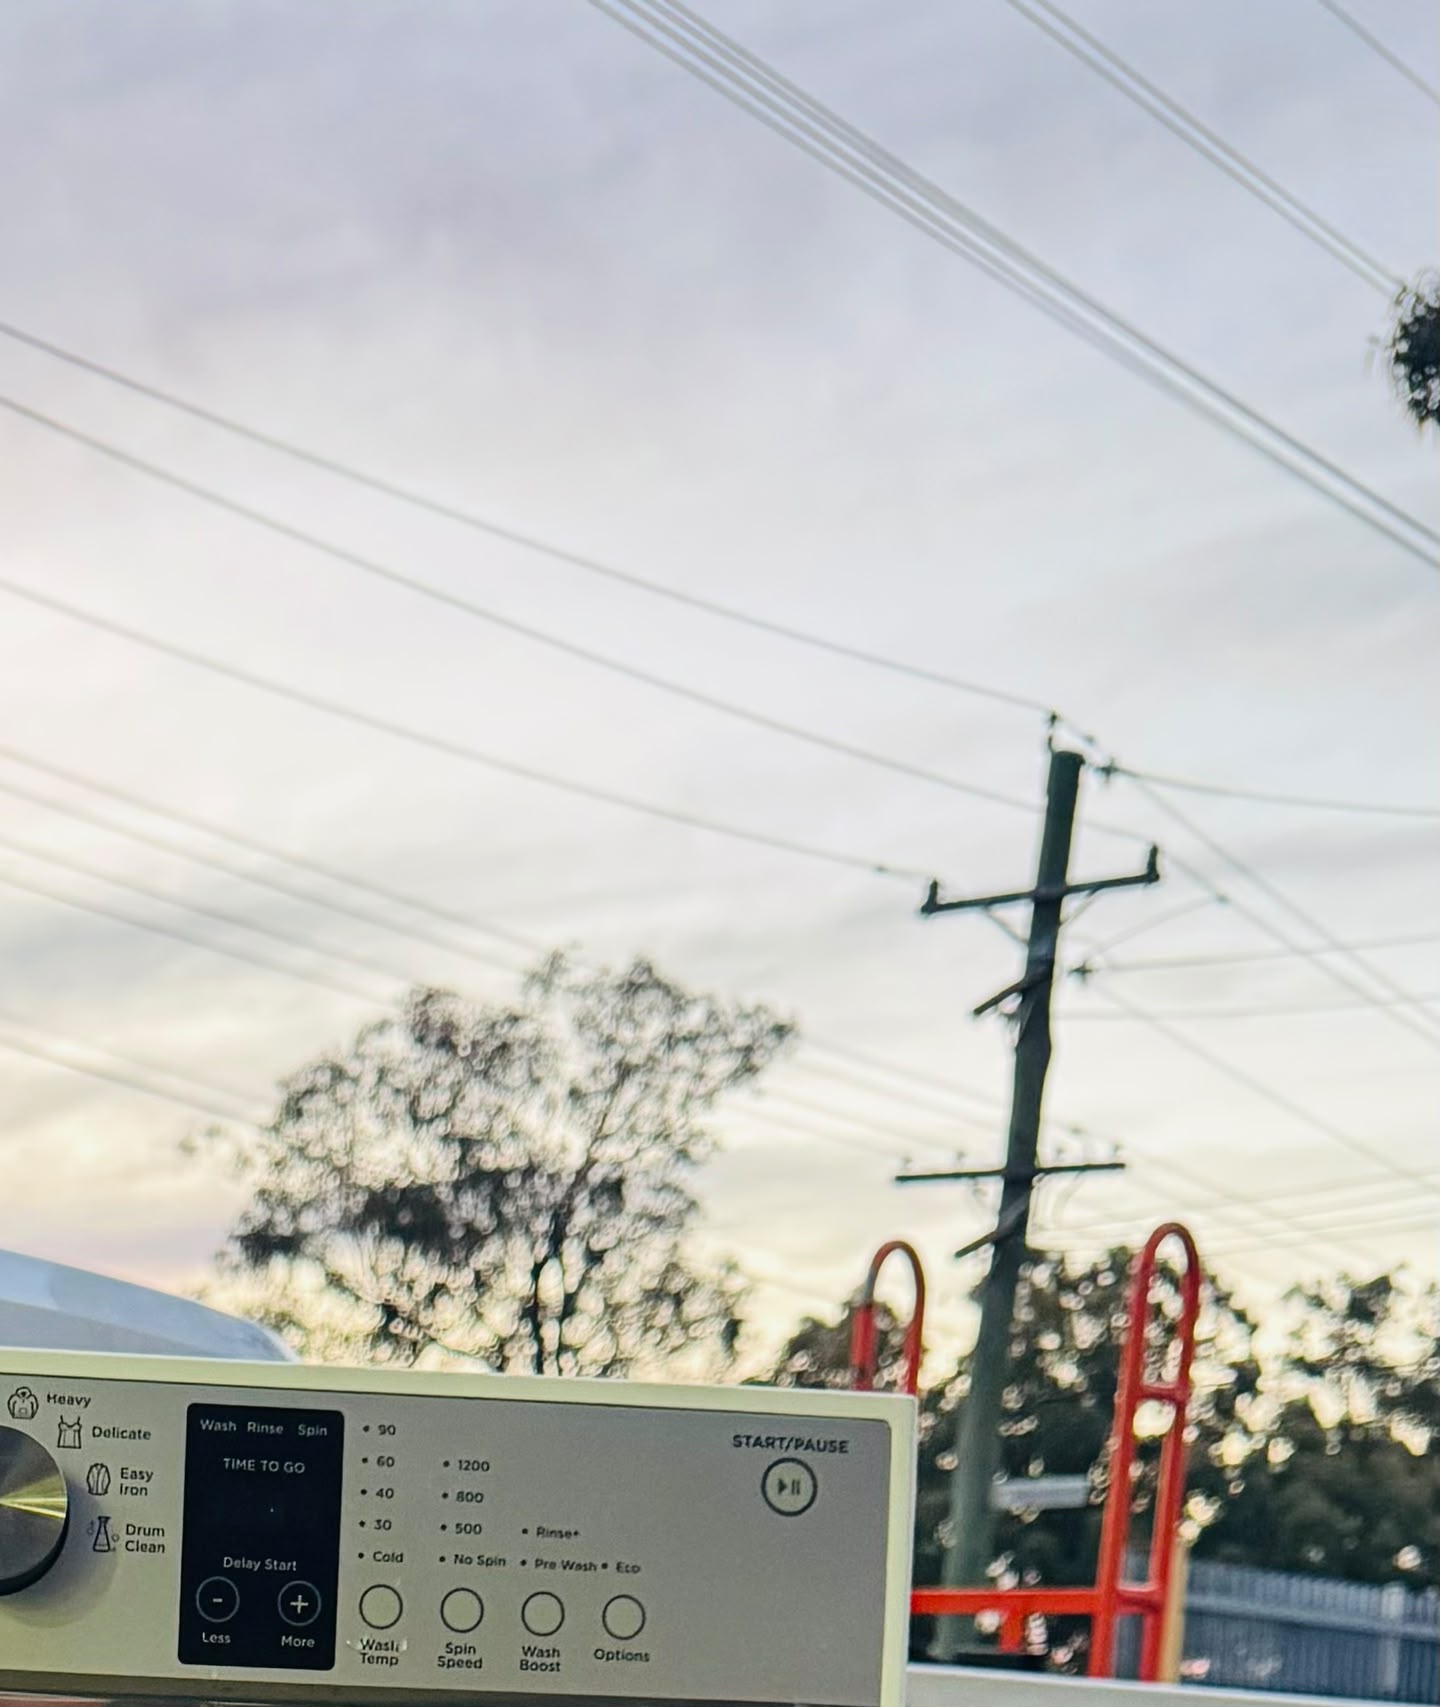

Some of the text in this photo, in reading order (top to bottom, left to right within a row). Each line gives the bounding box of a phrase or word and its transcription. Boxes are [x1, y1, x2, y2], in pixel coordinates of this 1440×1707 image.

[47, 1393, 91, 1409] Heavy
[92, 1426, 151, 1441] Delicate
[200, 1419, 328, 1438] Wash Rinse Spin
[378, 1424, 396, 1436] 90
[732, 1434, 850, 1454] START/PAUSE
[223, 1458, 306, 1474] TIME TO GO
[376, 1456, 395, 1467] 60
[458, 1459, 490, 1472] 1200
[120, 1467, 154, 1484] Easy
[119, 1483, 148, 1497] Iron
[375, 1488, 394, 1499] 40
[456, 1491, 484, 1503] 800
[125, 1523, 165, 1538] Drum
[374, 1519, 392, 1531] 30
[455, 1523, 482, 1535] 500
[536, 1526, 579, 1539] Rinse+
[124, 1539, 166, 1554] Clean
[373, 1551, 404, 1563] Cold
[454, 1554, 506, 1567] No Spin
[223, 1556, 297, 1572] Delay Start
[535, 1558, 597, 1571] Pre Wash
[616, 1562, 641, 1573] Eco
[202, 1632, 231, 1645] Less
[281, 1634, 315, 1649] More
[445, 1641, 476, 1656] Spin
[521, 1645, 561, 1658] Wash
[360, 1652, 399, 1667] Temp
[593, 1648, 650, 1663] Options
[437, 1655, 483, 1671] Speed
[519, 1659, 561, 1672] Boost
